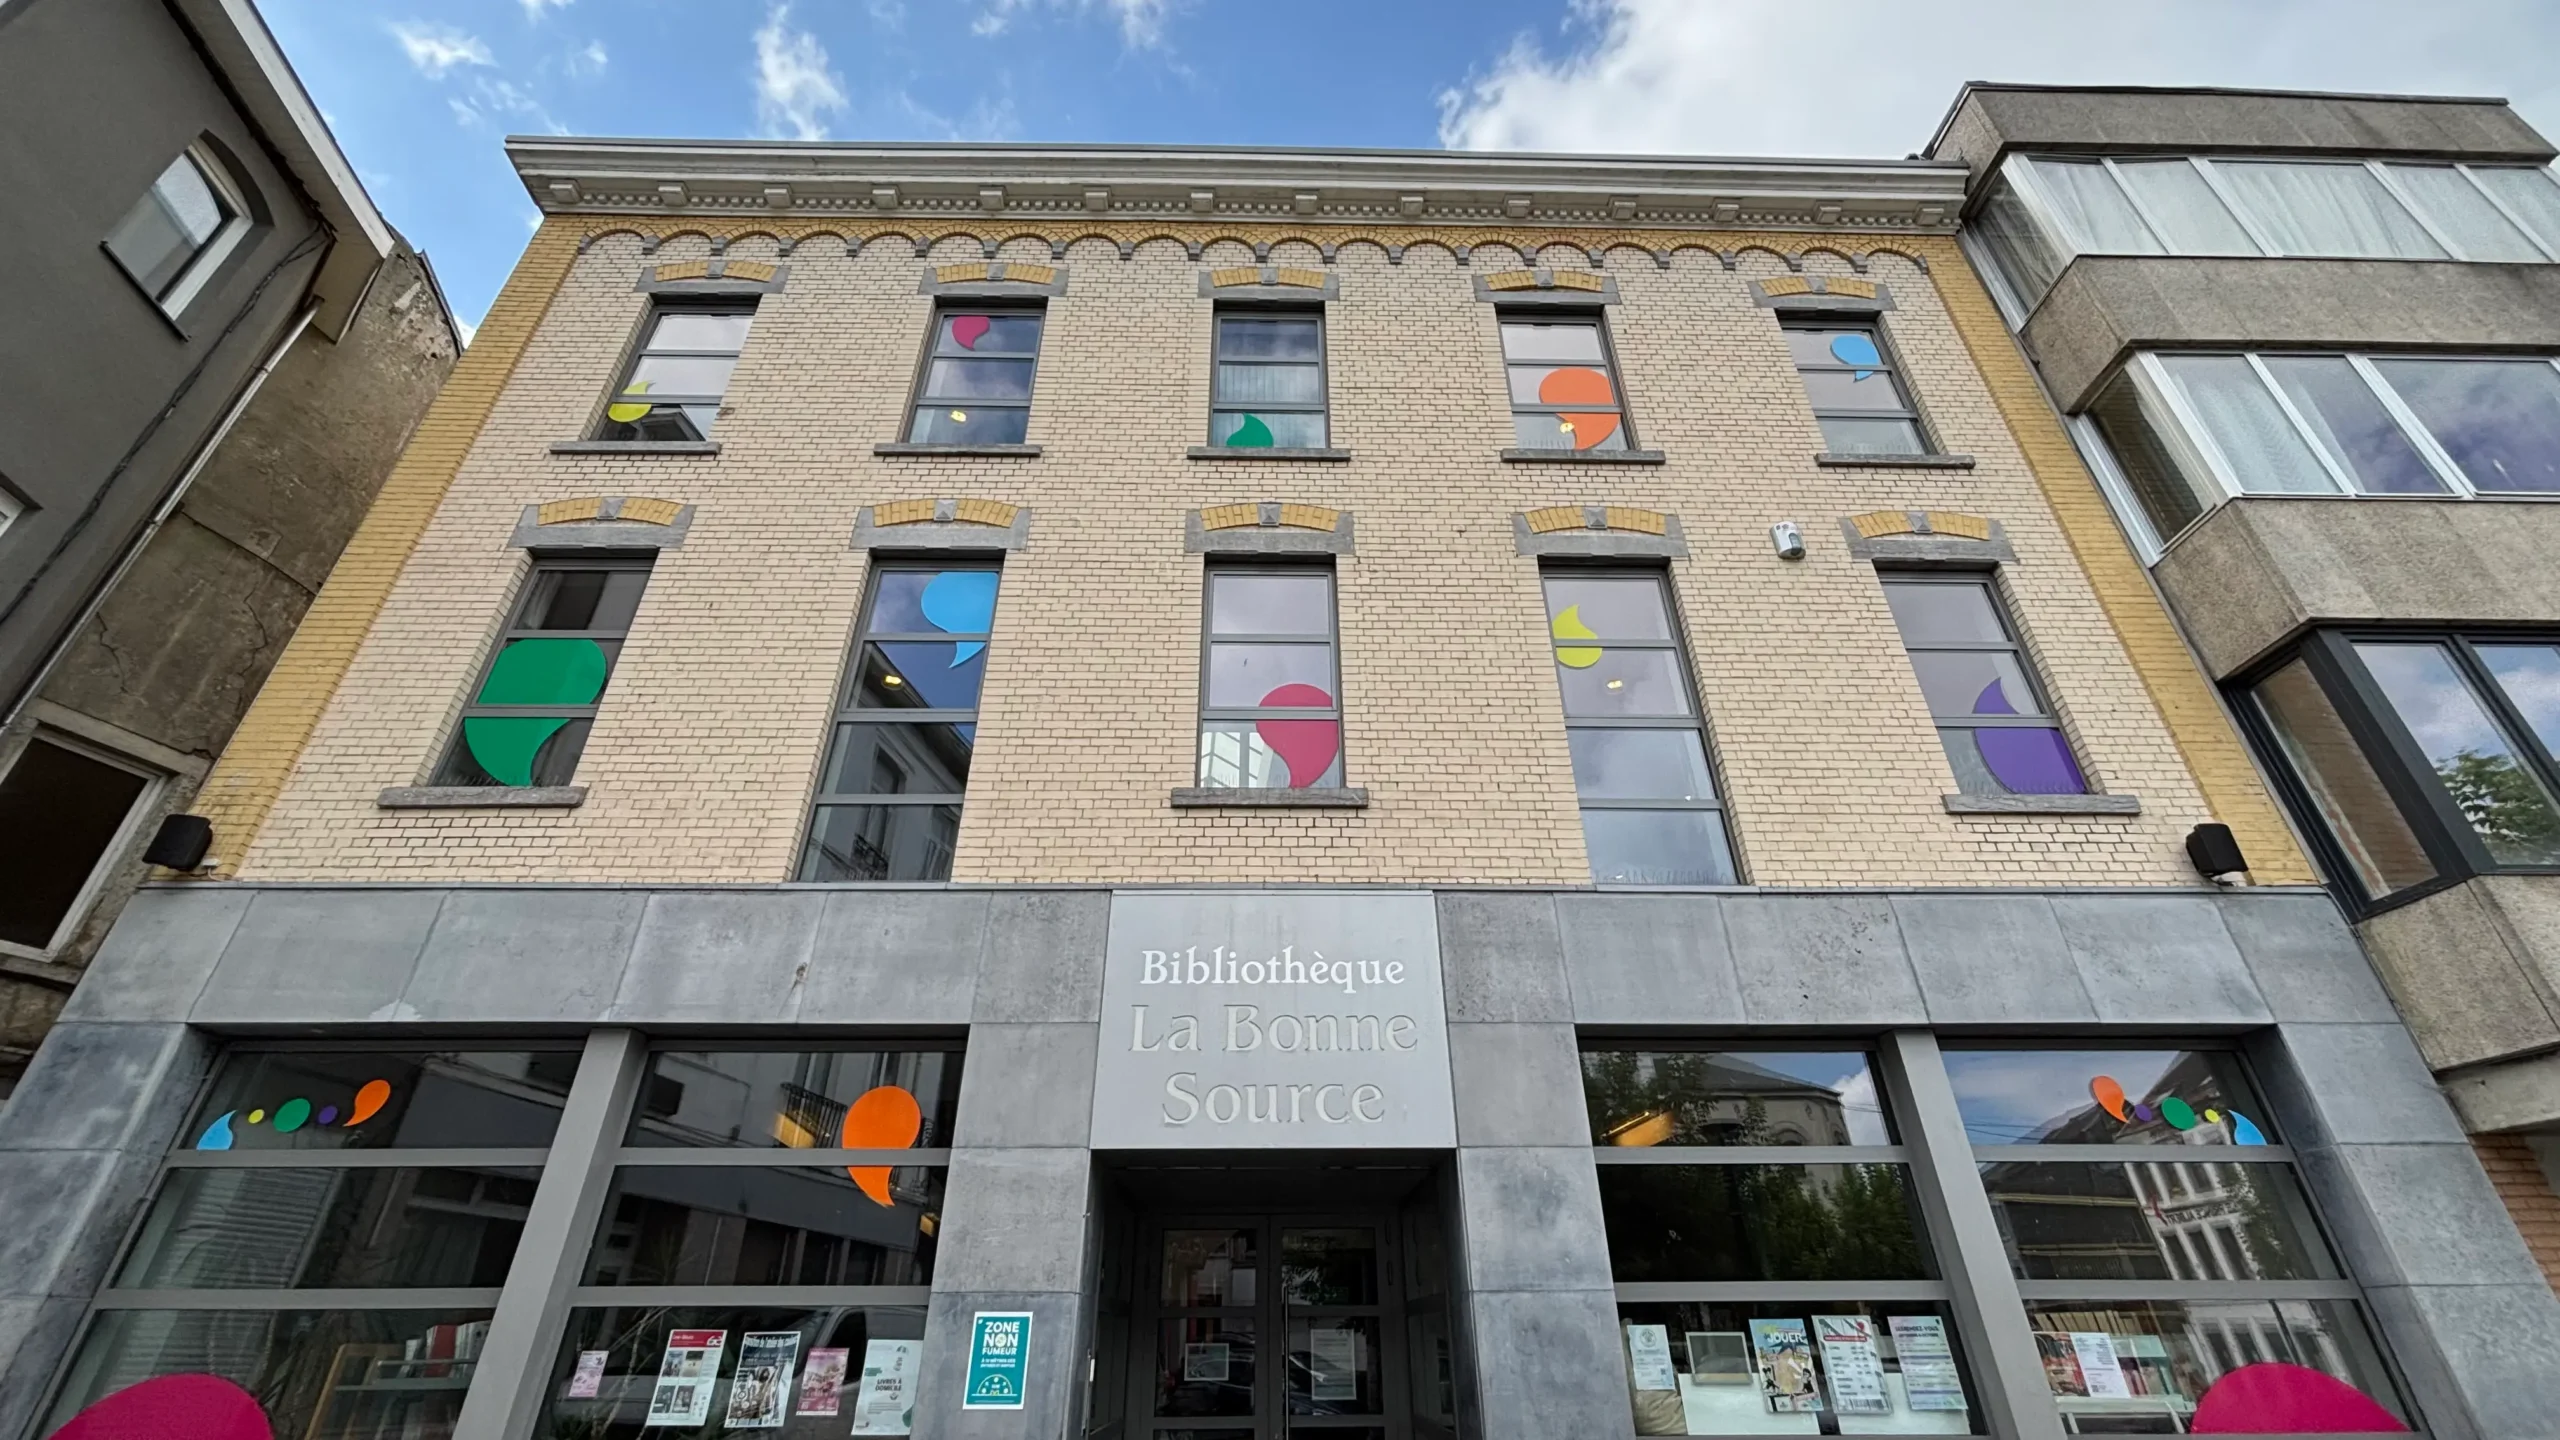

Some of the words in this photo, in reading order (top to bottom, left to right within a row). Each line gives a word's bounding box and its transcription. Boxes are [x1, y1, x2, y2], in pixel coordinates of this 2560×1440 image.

[1140, 945, 1405, 994] Bibliothèque
[1128, 1004, 1202, 1052] La
[1222, 1004, 1418, 1052] Bonne
[1162, 1072, 1385, 1126] Source
[985, 1321, 1020, 1333] ZONE
[983, 1333, 1019, 1347] NON
[1767, 1332, 1804, 1343] JOUER
[982, 1347, 1017, 1355] FUMEUR
